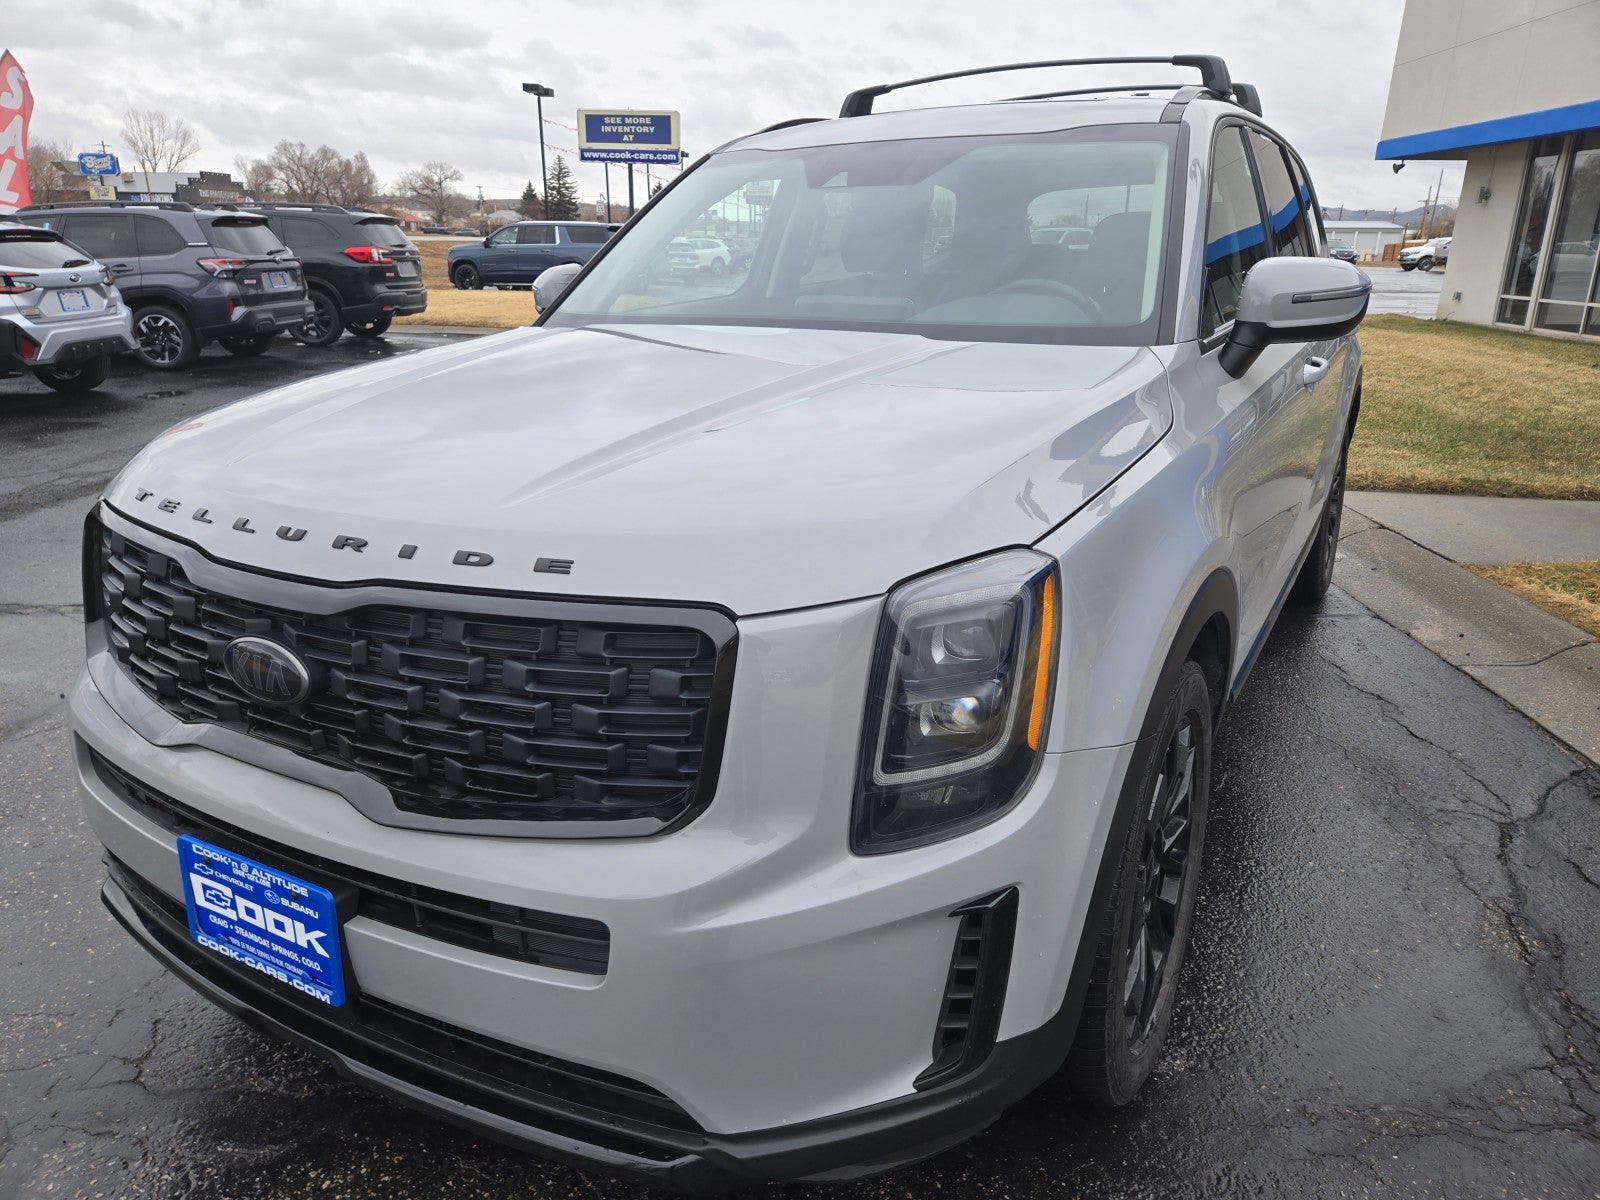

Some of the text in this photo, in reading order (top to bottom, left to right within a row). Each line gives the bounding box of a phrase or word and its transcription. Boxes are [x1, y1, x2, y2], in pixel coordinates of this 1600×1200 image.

[601, 125, 655, 133] INVENTORY
[604, 116, 622, 124] SEE
[0, 65, 25, 215] SAL
[622, 134, 635, 142] AT
[583, 151, 677, 160] www.cook-cars.com
[134, 487, 575, 575] TELLURIDE
[214, 871, 254, 891] CHEVROLET
[251, 868, 309, 897] ALTITUDE
[280, 897, 319, 919] SUBARU
[235, 925, 270, 949] STEAMBOAT
[197, 935, 331, 1005] COOK-CARS.COM
